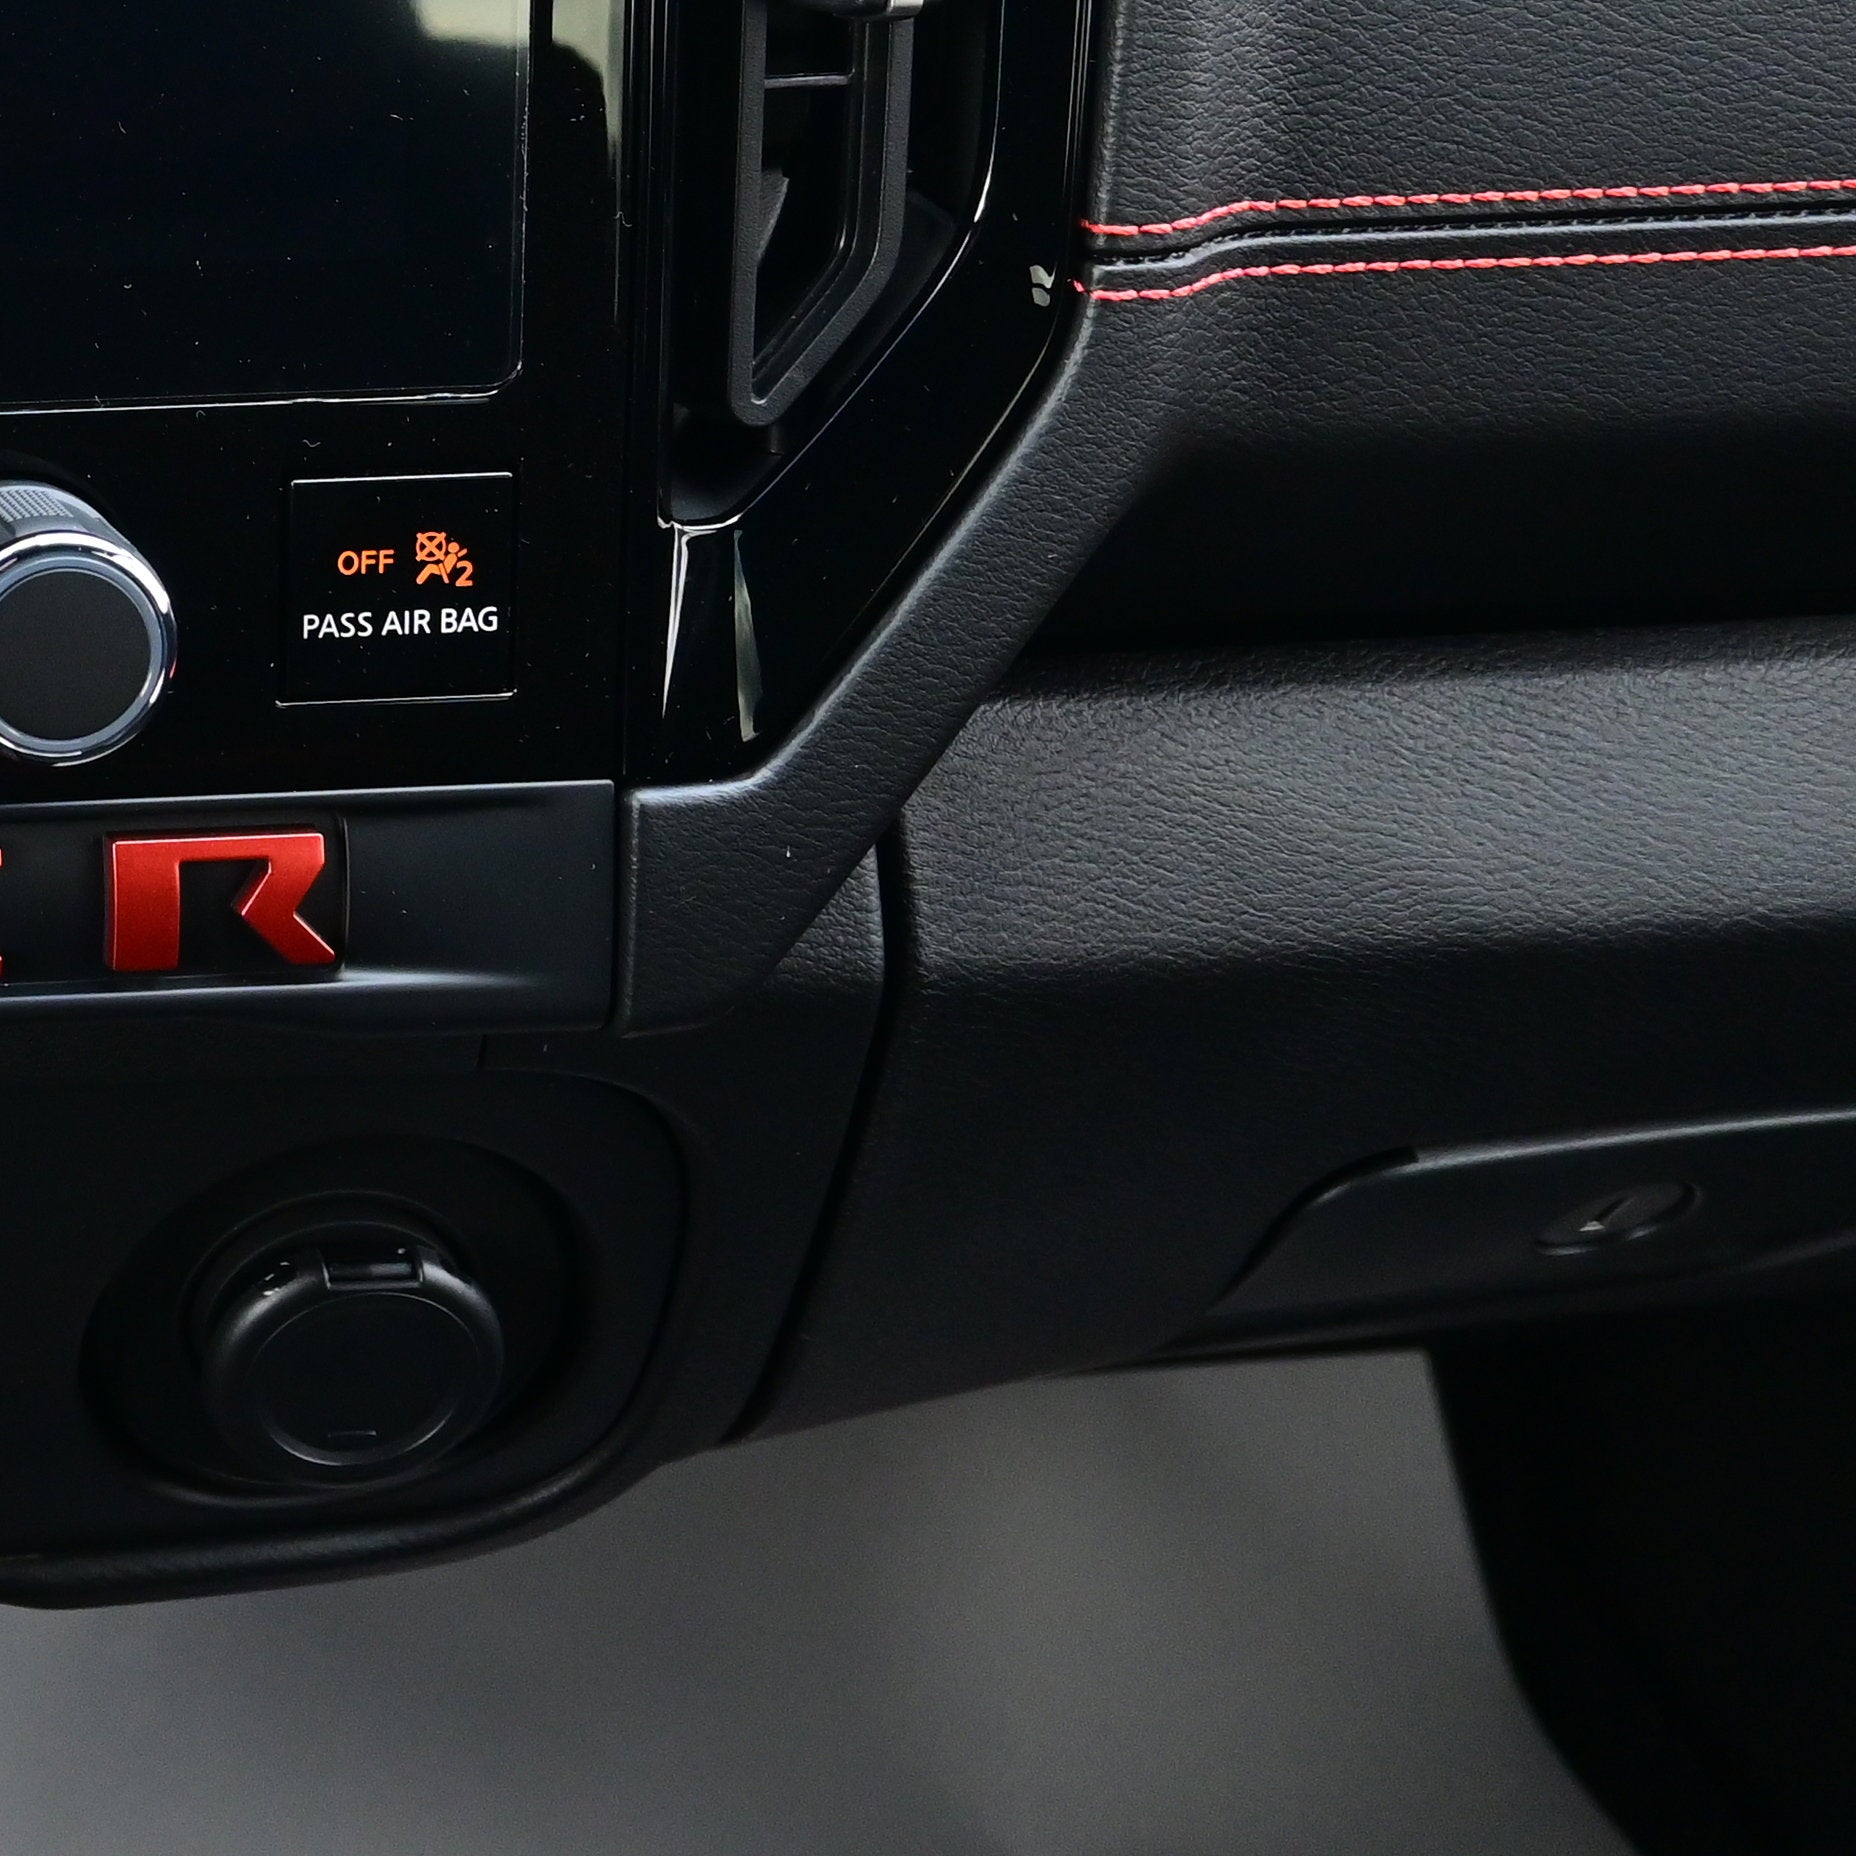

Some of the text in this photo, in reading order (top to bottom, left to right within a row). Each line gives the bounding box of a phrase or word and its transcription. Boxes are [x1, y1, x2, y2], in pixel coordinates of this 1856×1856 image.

[338, 549, 395, 575] OFF
[302, 606, 498, 640] PASS AIR BAG
